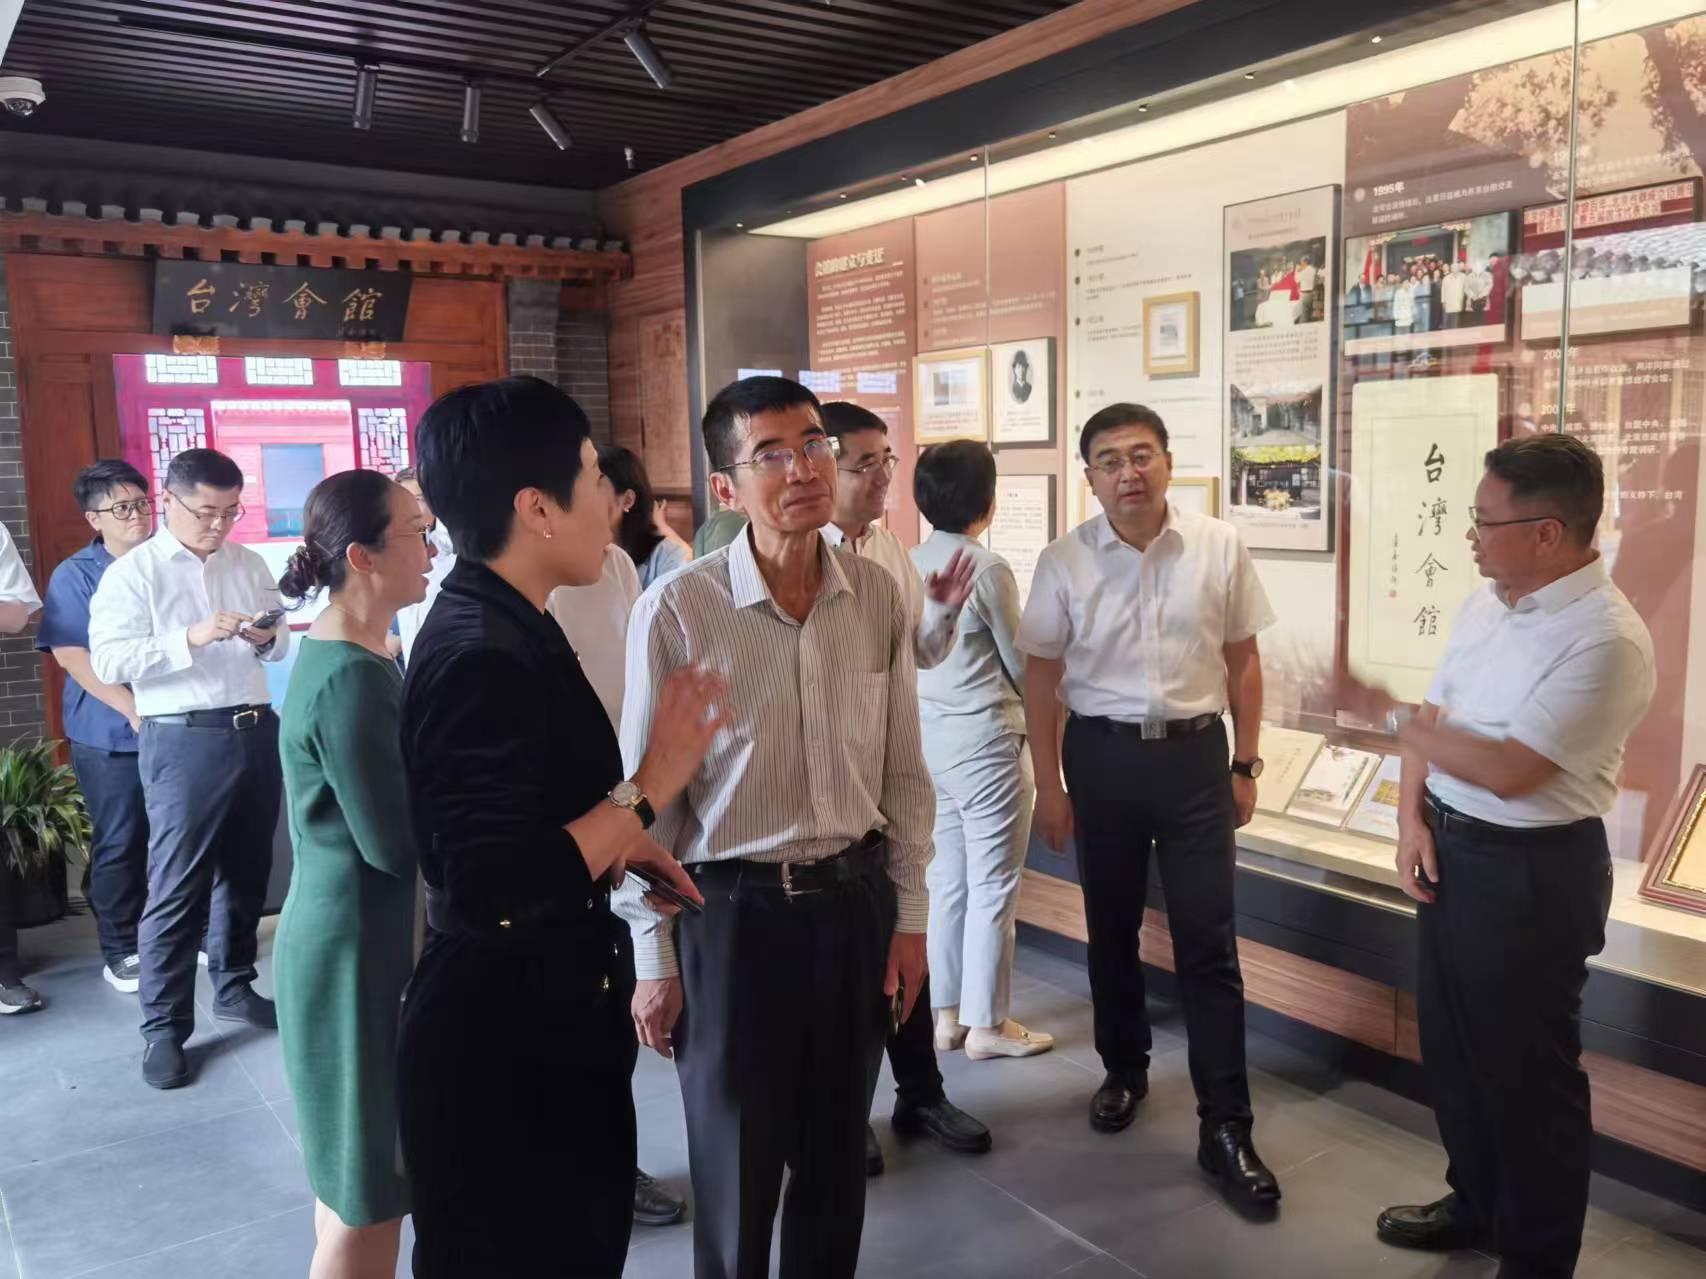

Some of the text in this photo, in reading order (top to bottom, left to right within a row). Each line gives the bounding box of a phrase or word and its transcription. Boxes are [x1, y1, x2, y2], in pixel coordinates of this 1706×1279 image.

[187, 278, 382, 322] 台灣會館
[1413, 443, 1449, 636] 台灣會館
